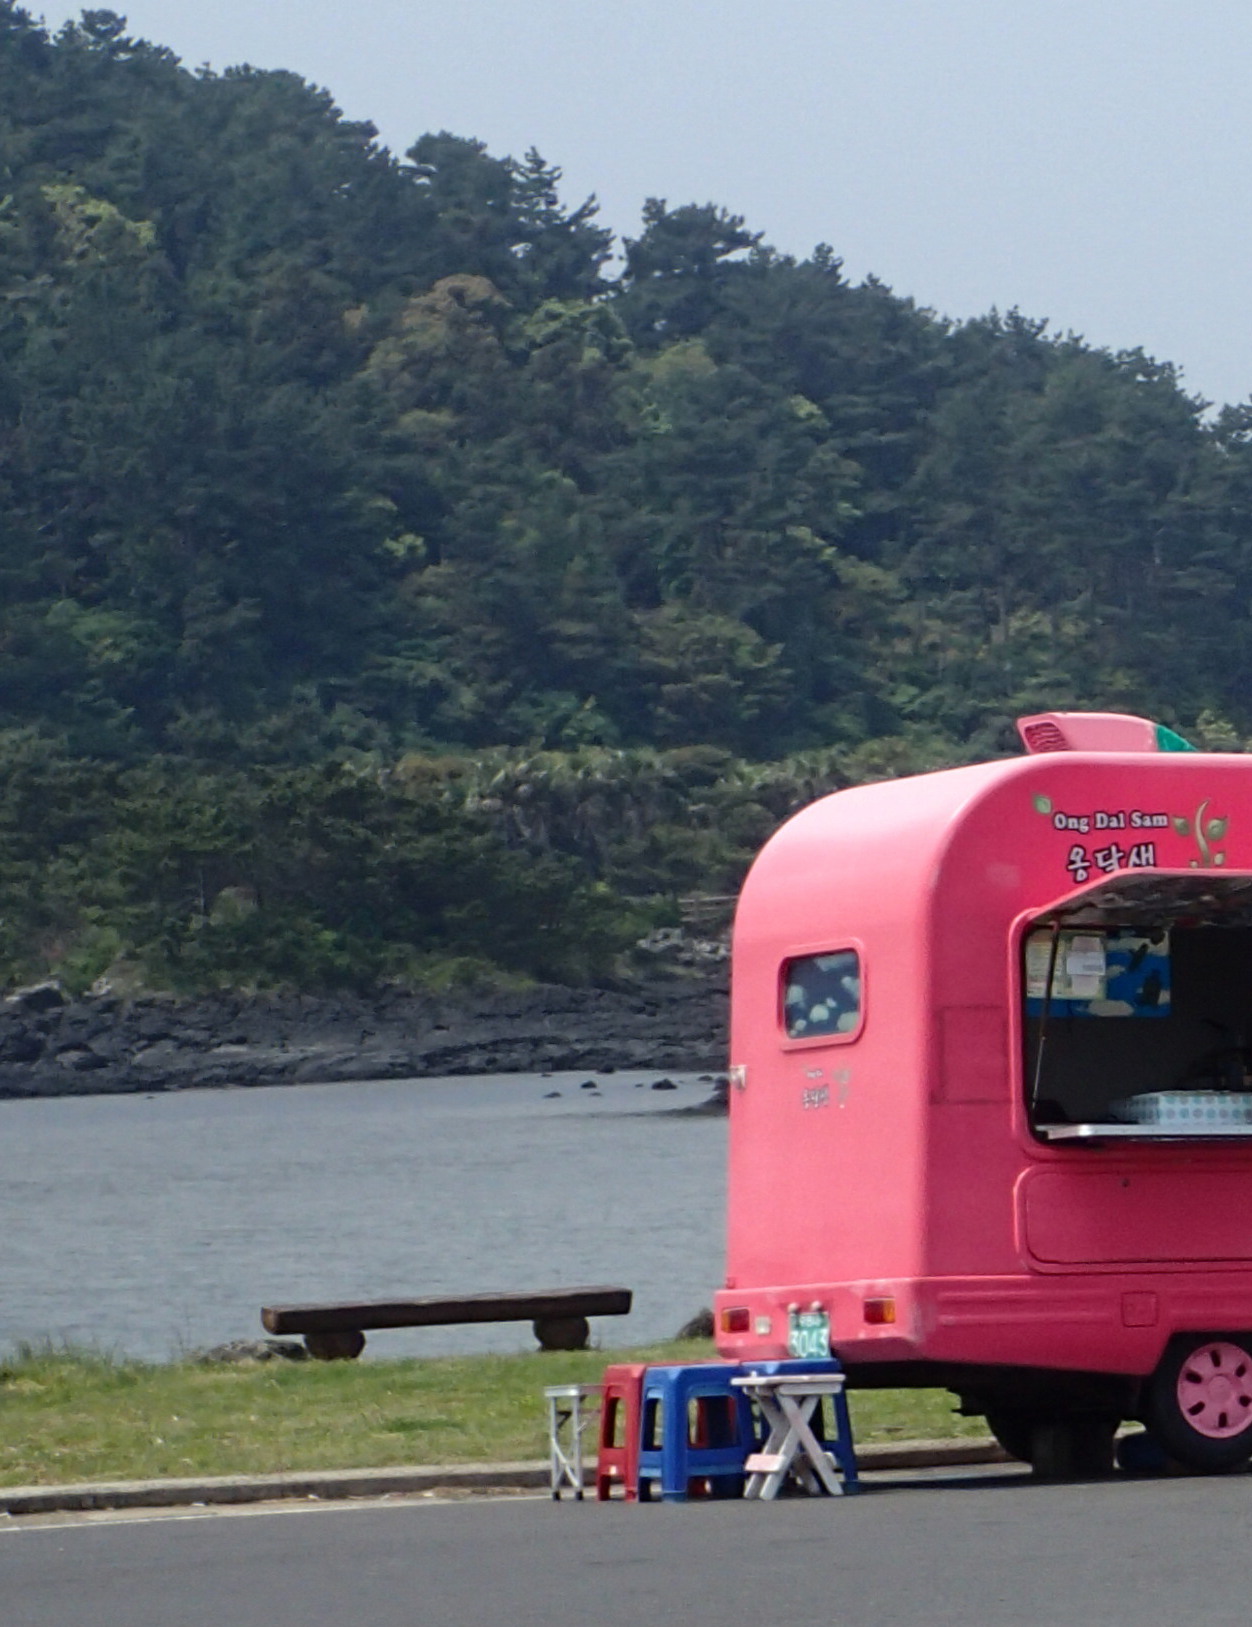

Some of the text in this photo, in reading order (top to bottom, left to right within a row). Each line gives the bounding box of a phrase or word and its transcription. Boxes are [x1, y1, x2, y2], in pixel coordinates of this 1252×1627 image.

[1054, 811, 1169, 833] Ong Dal Sam
